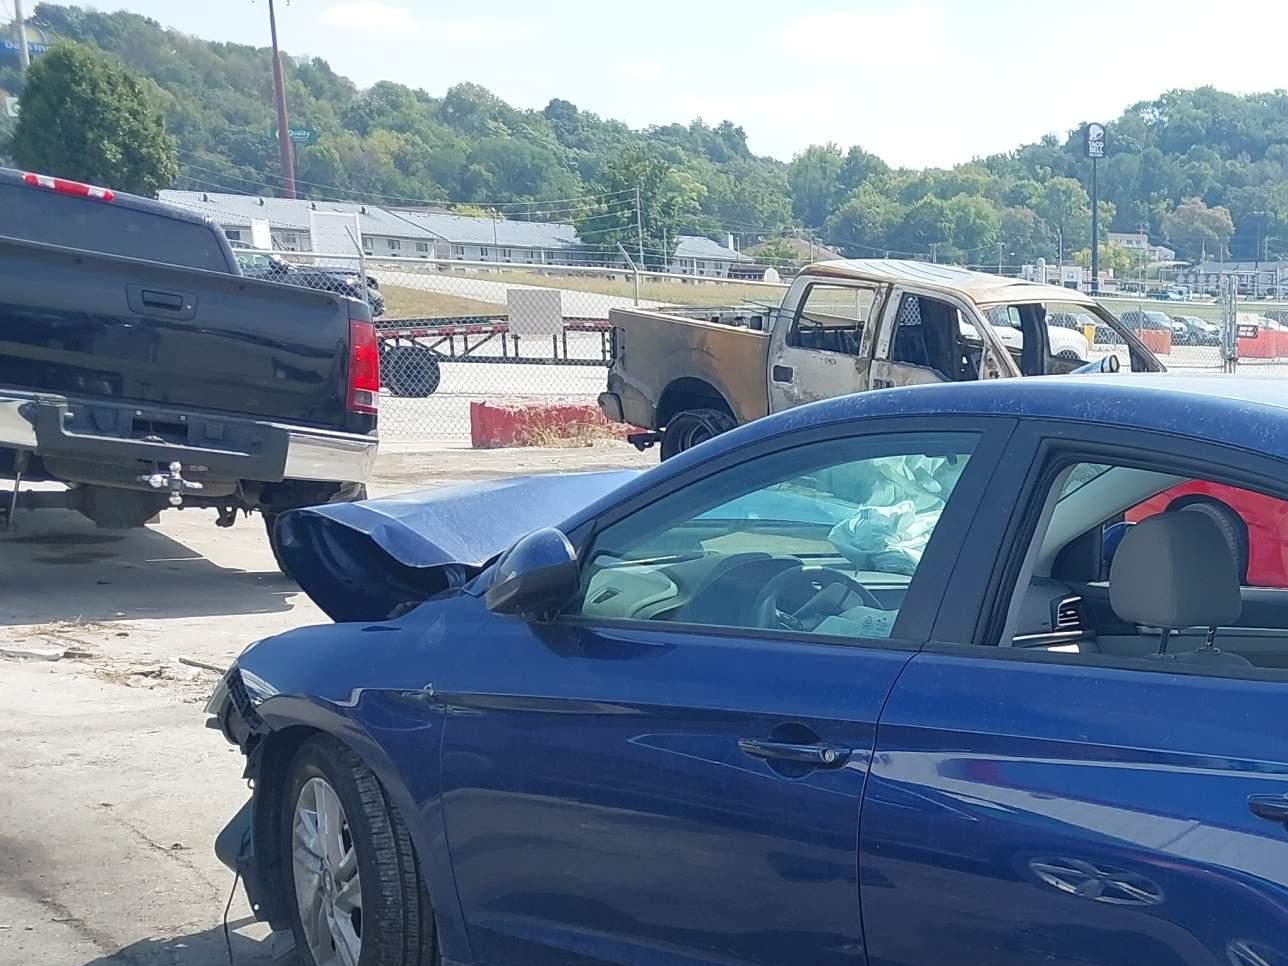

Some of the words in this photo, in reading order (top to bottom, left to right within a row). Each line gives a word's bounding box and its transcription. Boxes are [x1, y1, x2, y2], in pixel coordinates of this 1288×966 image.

[4, 41, 32, 50] Das
[287, 129, 311, 138] Quality
[1088, 140, 1104, 148] TACO
